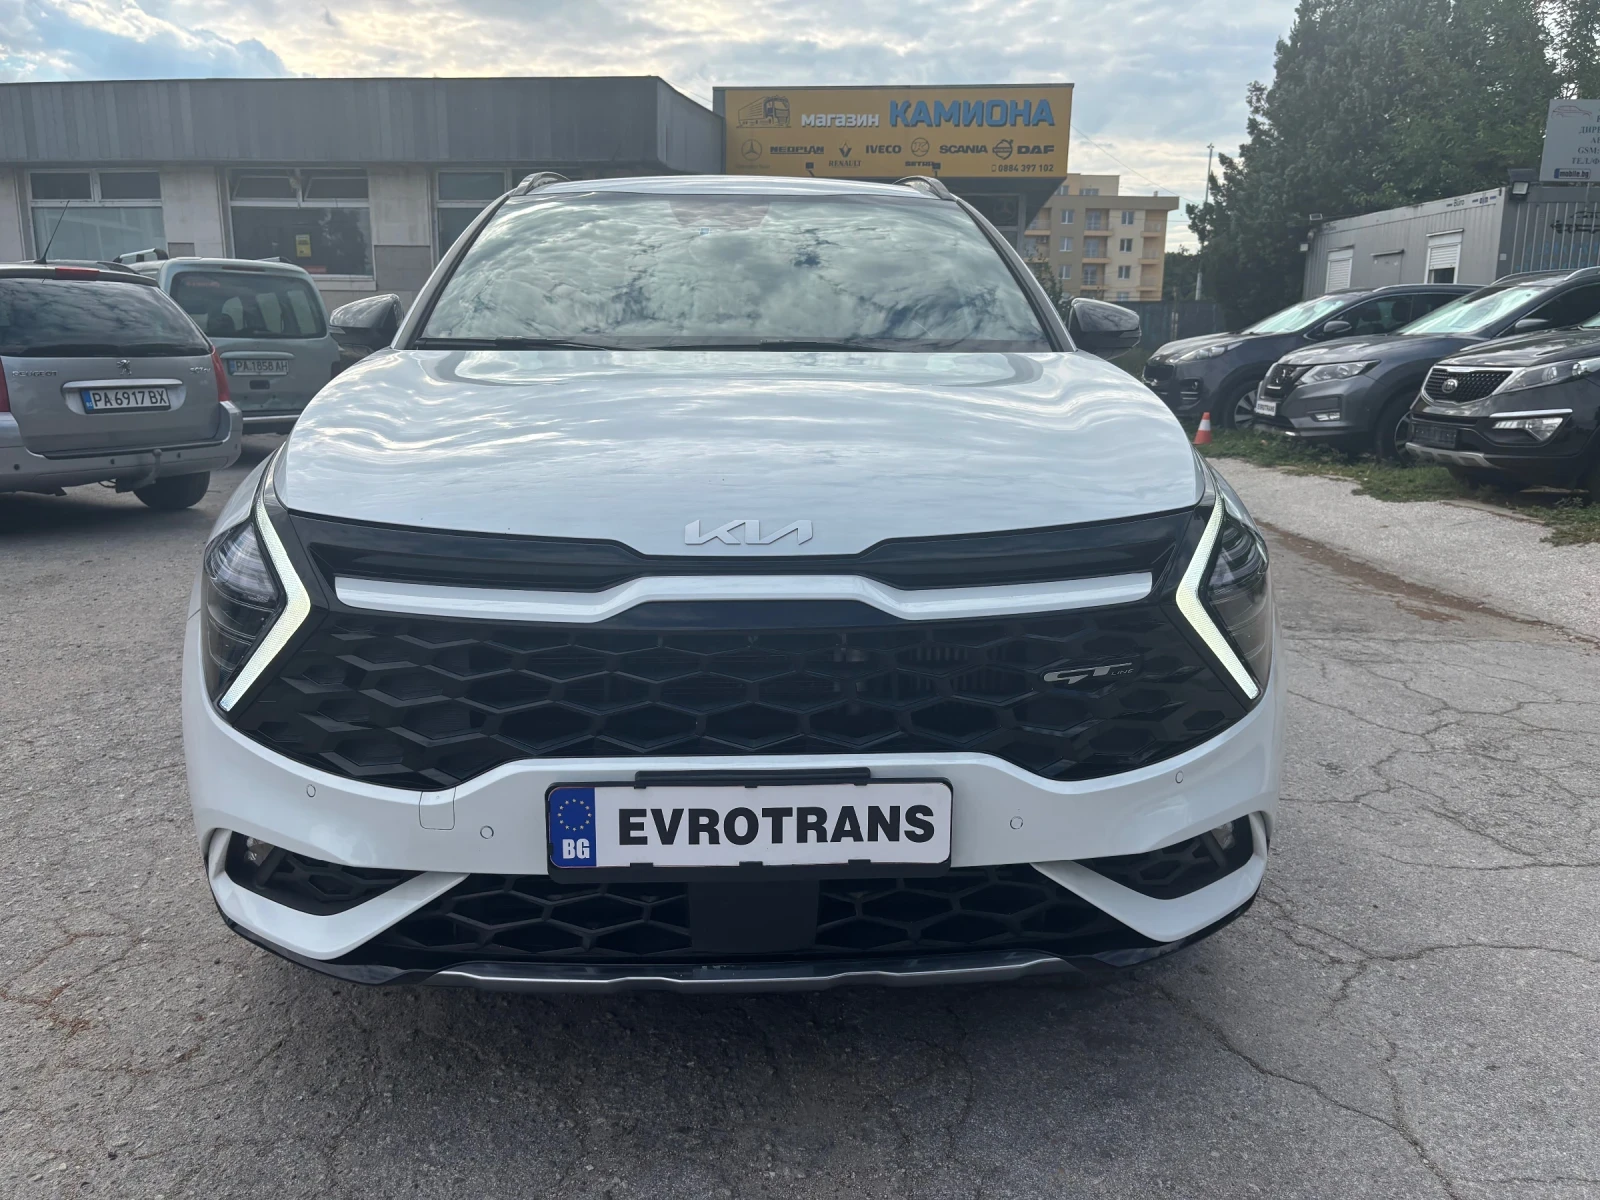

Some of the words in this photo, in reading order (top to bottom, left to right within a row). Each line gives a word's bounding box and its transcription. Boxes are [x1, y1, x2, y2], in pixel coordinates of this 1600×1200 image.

[801, 113, 880, 128] магазин
[889, 99, 1055, 127] КАМИОНА
[770, 145, 824, 154] NEOPLAN
[866, 145, 902, 154] IVECO
[939, 145, 988, 154] SCANIA
[1017, 145, 1055, 155] DAF
[998, 164, 1019, 172] 0884
[1021, 164, 1036, 172] 397
[1039, 164, 1054, 172] 102
[92, 391, 113, 407] PA
[115, 390, 146, 406] 6917
[148, 389, 167, 405] BX
[684, 519, 813, 545] KIA
[1043, 662, 1132, 685] GT
[1111, 668, 1134, 676] LINE
[562, 838, 590, 859] BG
[618, 804, 935, 846] EVROTRANS
